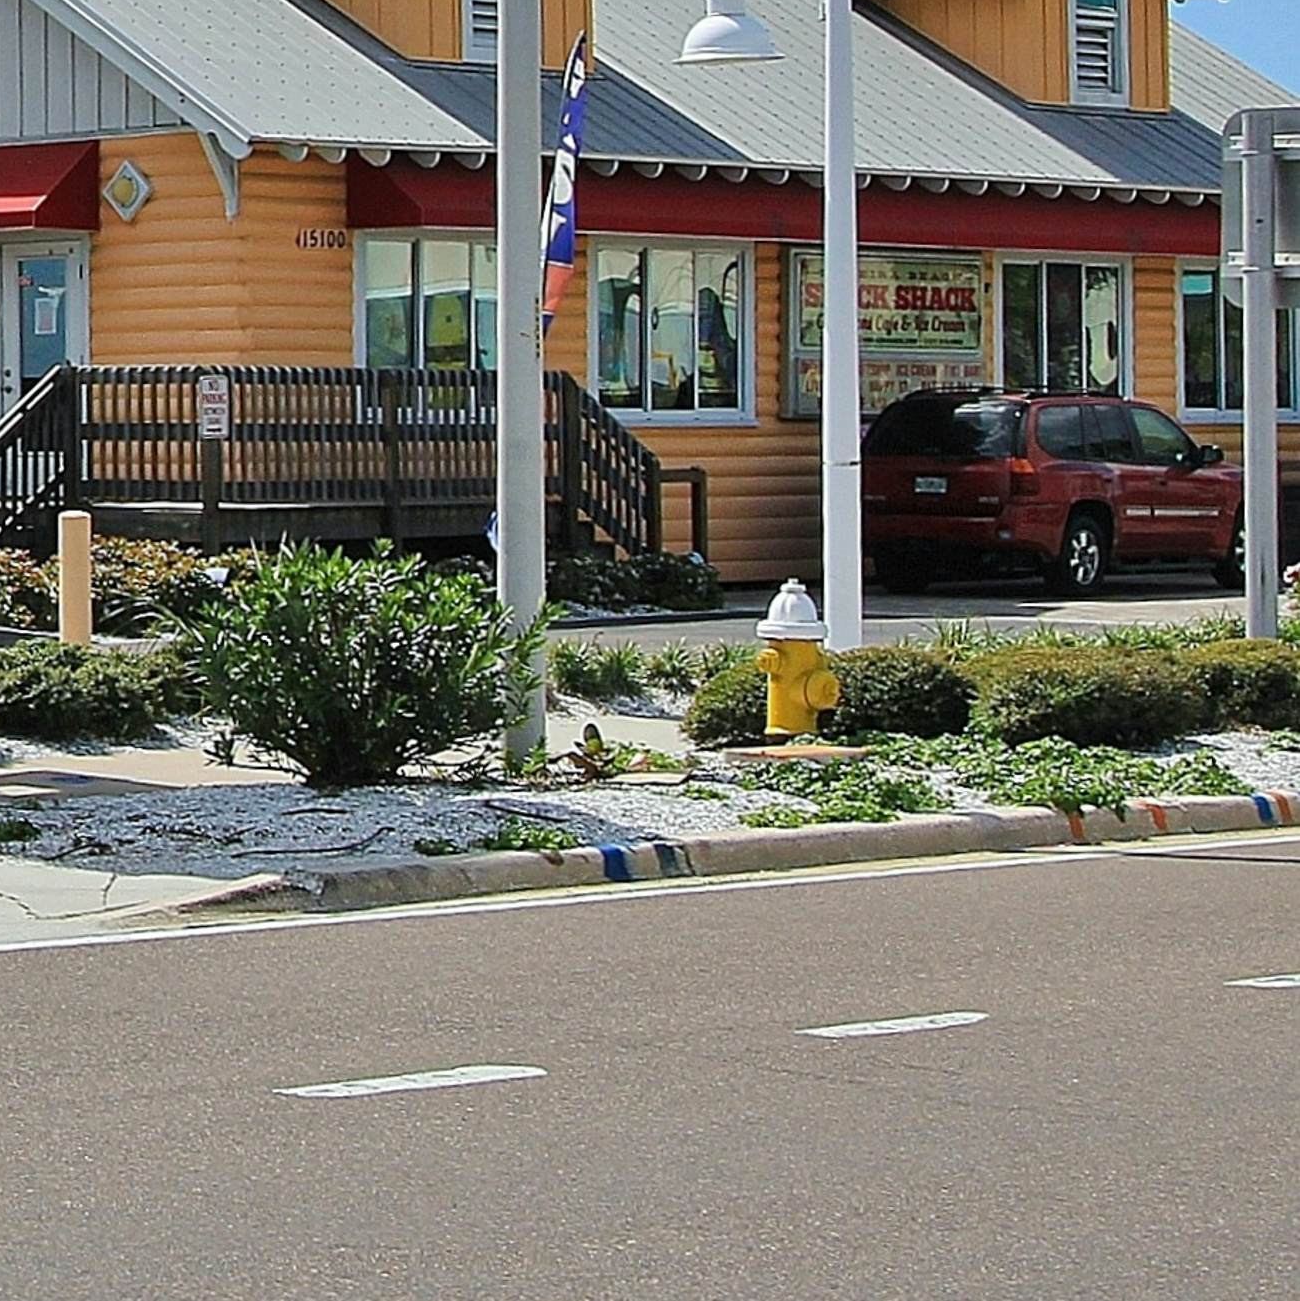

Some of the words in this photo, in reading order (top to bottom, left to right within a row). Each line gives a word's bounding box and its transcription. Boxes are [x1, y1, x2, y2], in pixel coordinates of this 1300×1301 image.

[303, 229, 346, 249] 15100
[804, 283, 889, 310] SCK
[893, 285, 977, 312] SHACK
